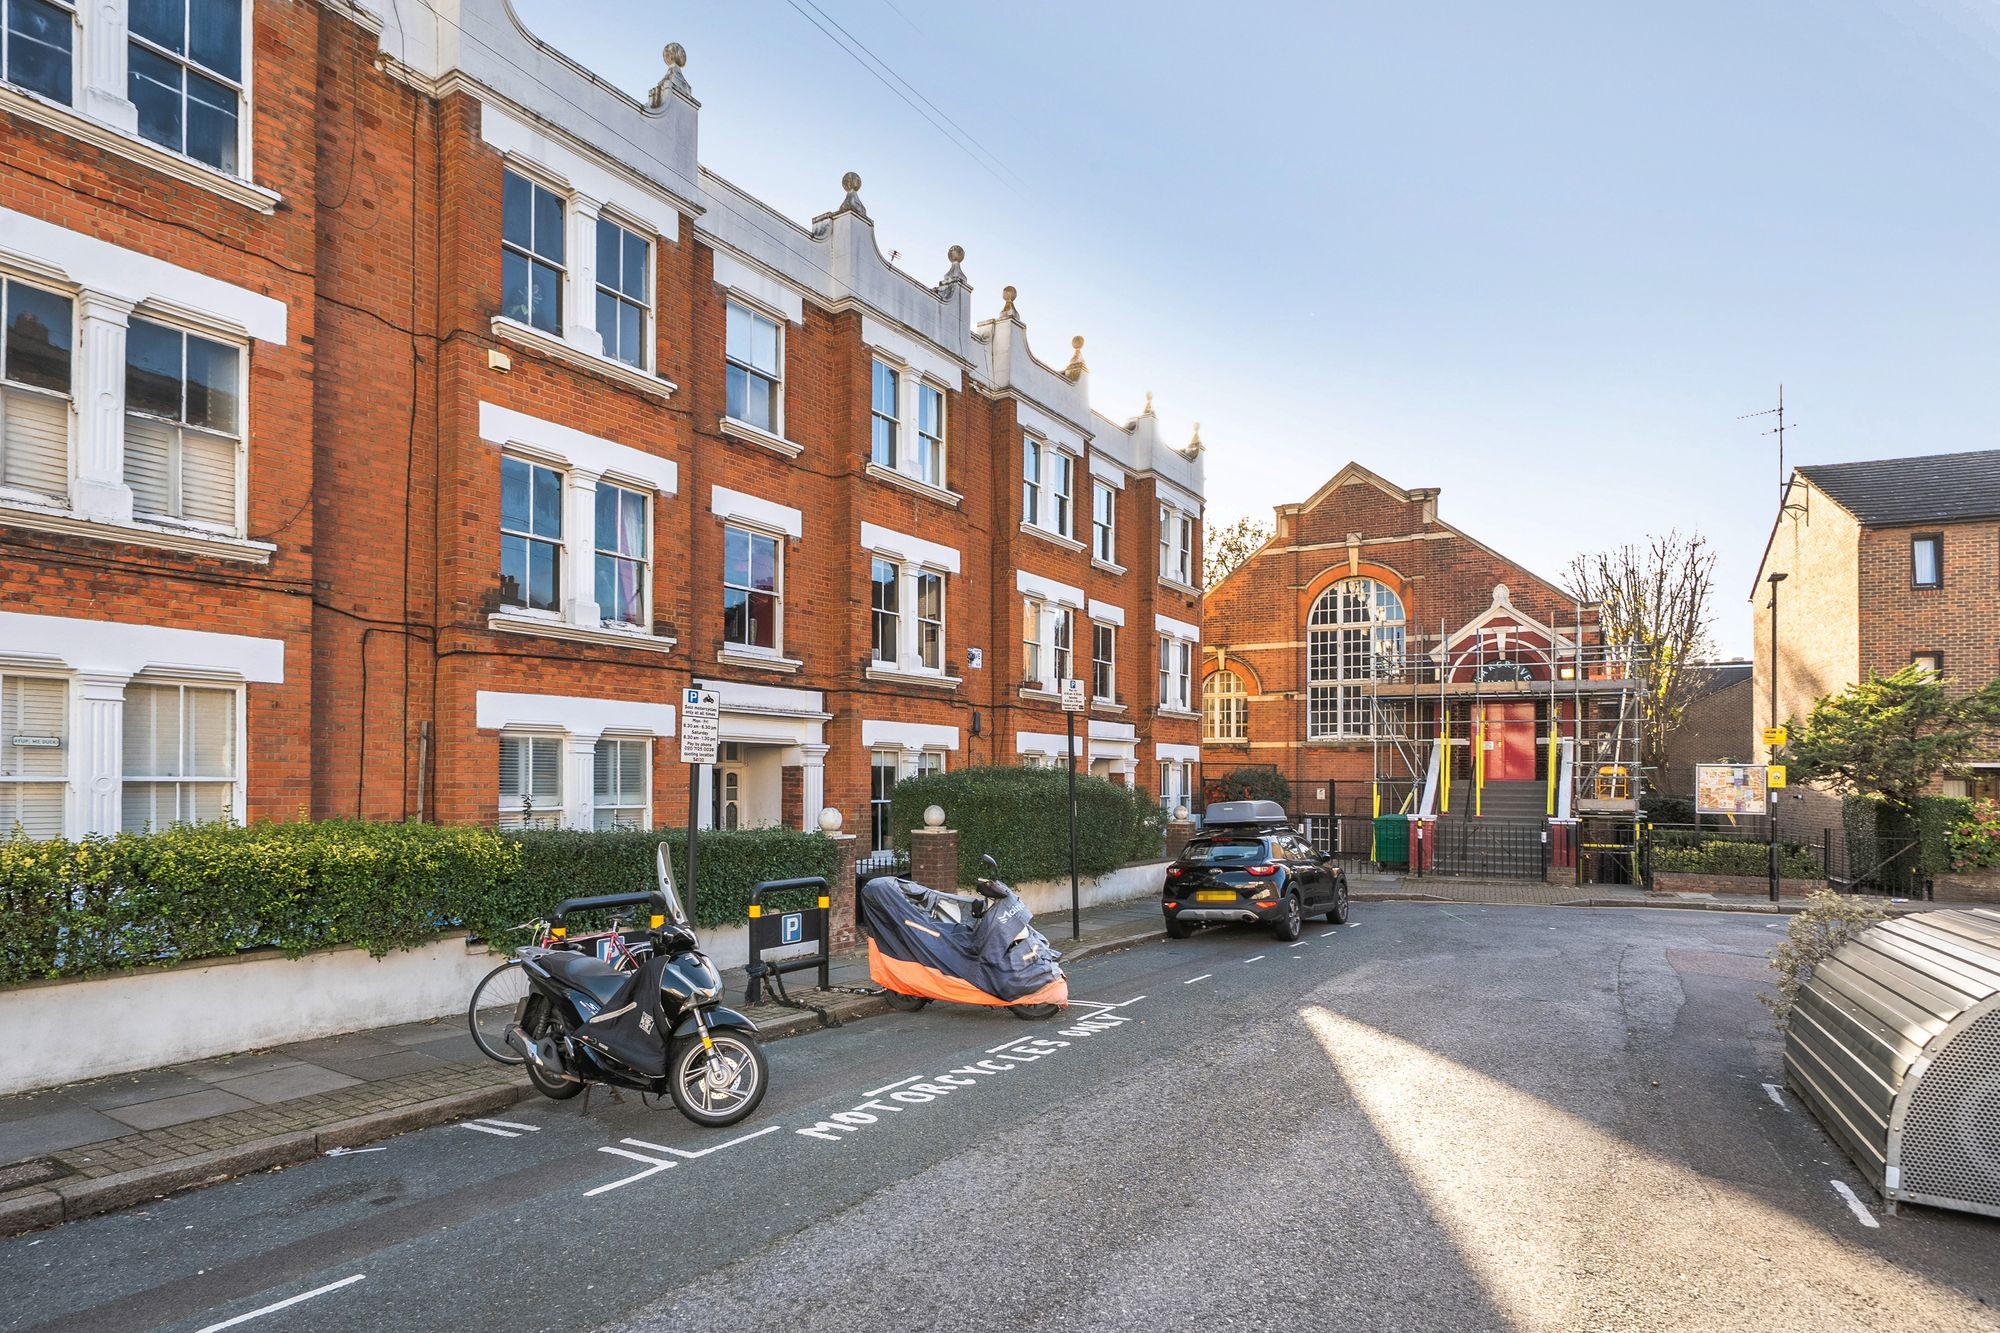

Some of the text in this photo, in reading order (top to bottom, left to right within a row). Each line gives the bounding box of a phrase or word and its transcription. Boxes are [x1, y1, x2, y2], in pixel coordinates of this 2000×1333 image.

[690, 692, 697, 702] P
[787, 917, 798, 940] P
[795, 1013, 1132, 1141] MOTORCYCLES ONLY
